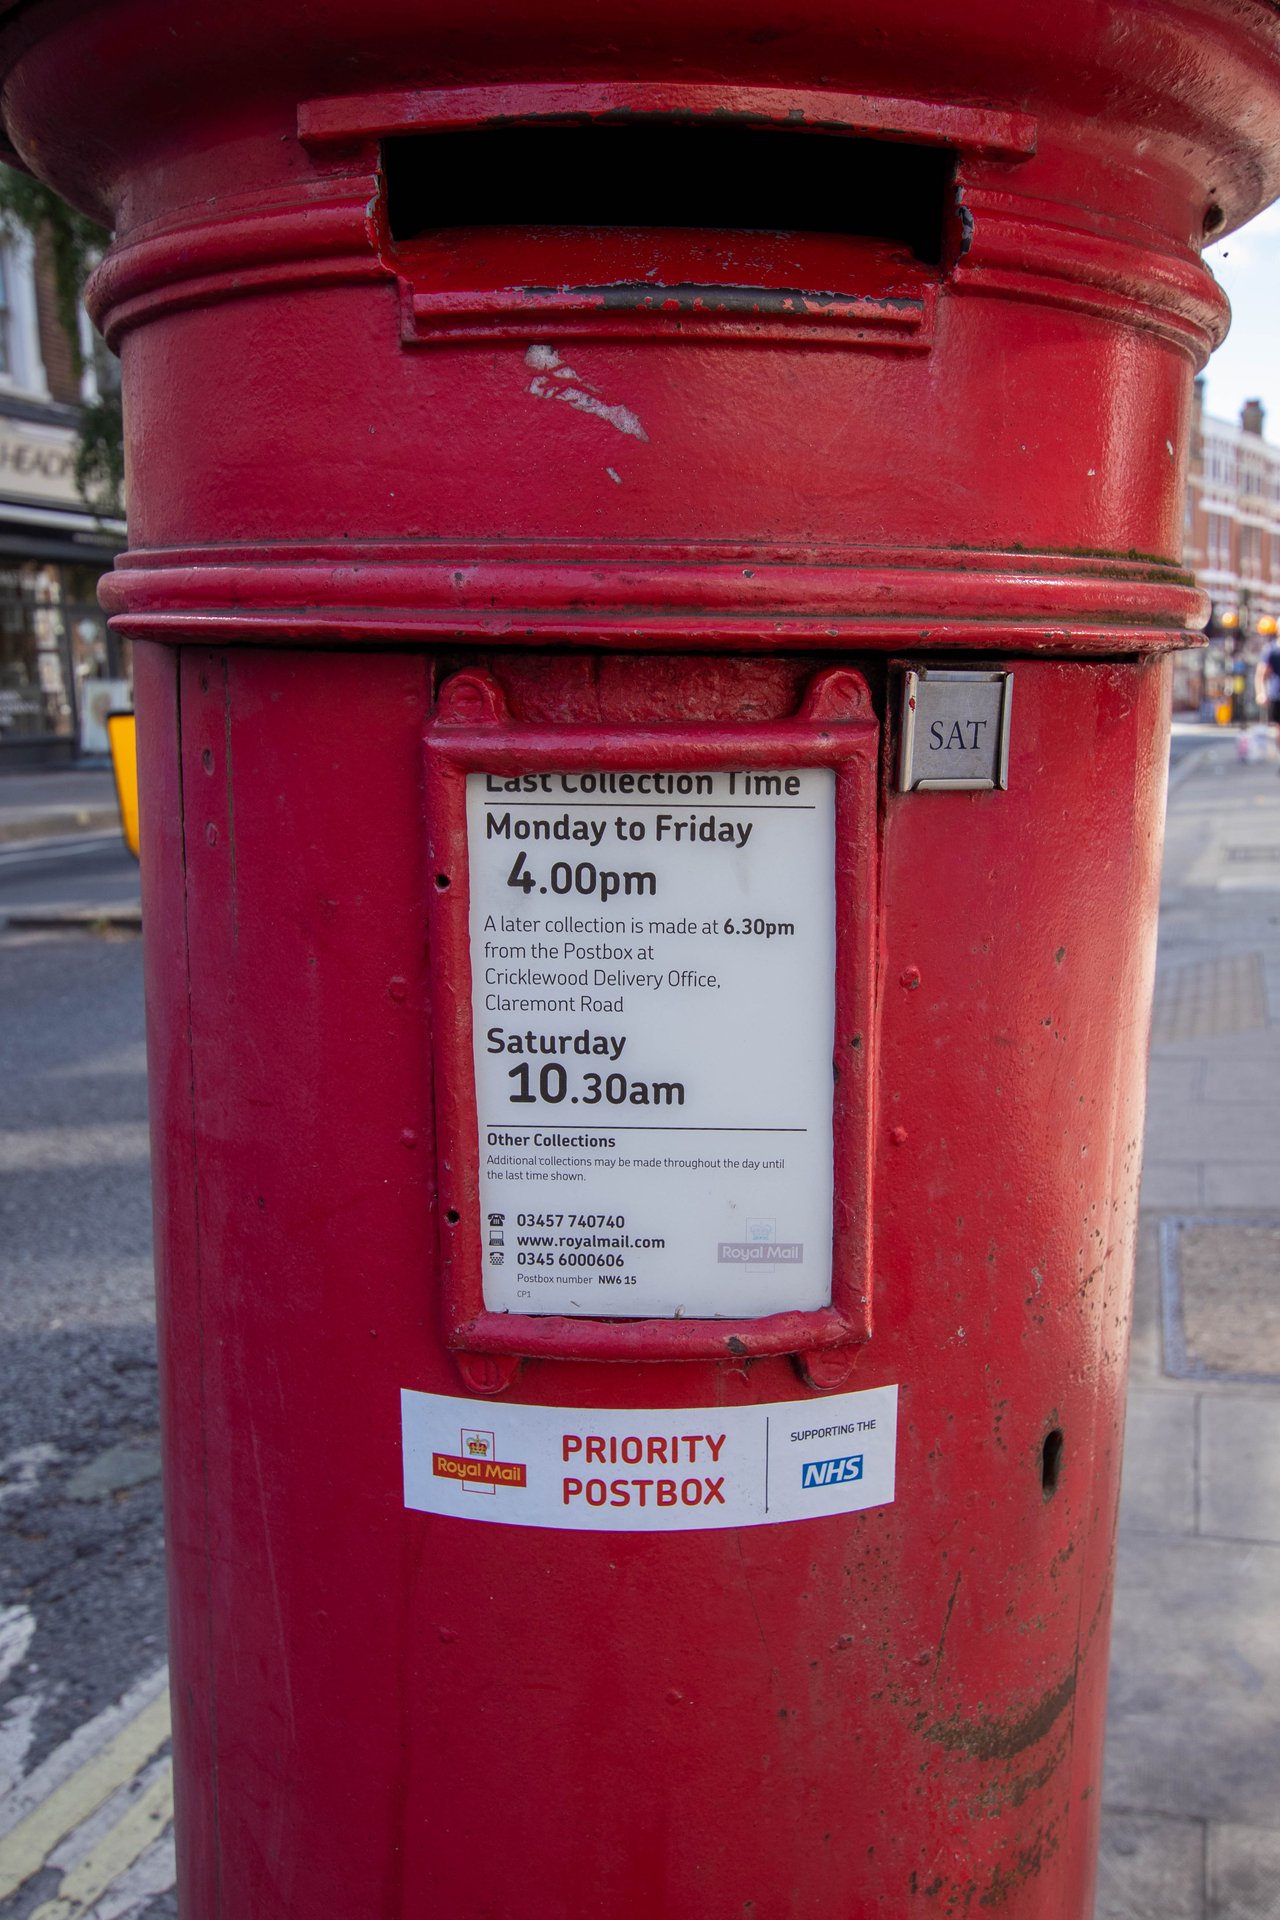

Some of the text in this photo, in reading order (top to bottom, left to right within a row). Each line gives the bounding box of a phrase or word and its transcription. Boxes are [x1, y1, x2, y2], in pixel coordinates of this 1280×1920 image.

[930, 720, 987, 750] SAT
[486, 772, 800, 795] Last Collection Time
[487, 812, 752, 848] Monday to Friday
[507, 851, 656, 902] 4.00pm
[484, 915, 794, 938] A later collection is made at 6.30pm
[485, 942, 654, 960] from the Postbox at
[486, 968, 720, 990] Cricklewood Delivery Office,
[486, 994, 623, 1012] Claremont Road
[487, 1028, 626, 1060] Saturday
[509, 1062, 684, 1105] 10.30am
[488, 1133, 615, 1147] Other Collections
[487, 1155, 784, 1171] Additional collections may be made throughout the day until
[487, 1170, 586, 1182] the last time shown.
[517, 1214, 624, 1229] 03457 740740
[517, 1235, 665, 1250] www.royalmail.com
[721, 1244, 799, 1261] Royal Mail
[518, 1253, 624, 1268] 0345 6000606
[518, 1274, 636, 1285] Postbox number NW6 15
[517, 1290, 531, 1299] CP1
[791, 1420, 876, 1442] SUPPORTING THE
[563, 1434, 726, 1464] PRIORITY
[437, 1457, 520, 1480] Royal Mail
[806, 1457, 861, 1486] NHS
[563, 1477, 725, 1507] POSTBOX
